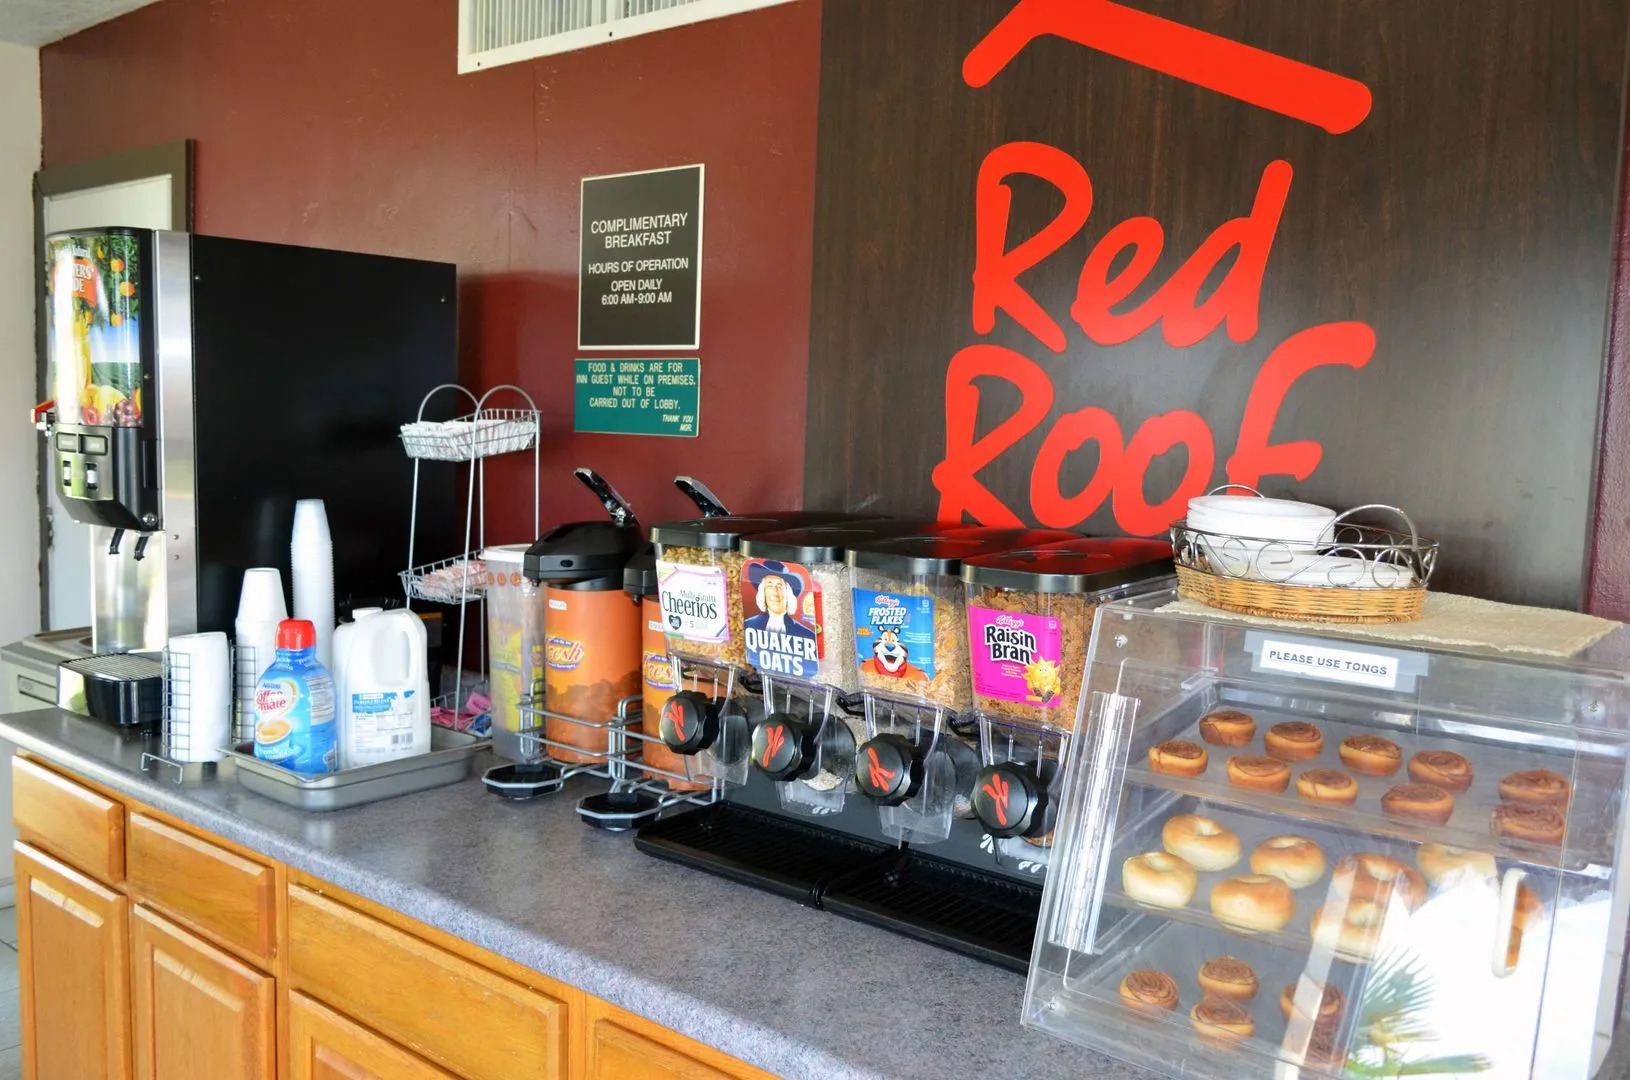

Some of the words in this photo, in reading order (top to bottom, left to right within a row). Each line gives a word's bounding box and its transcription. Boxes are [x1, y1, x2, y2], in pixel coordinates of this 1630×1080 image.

[590, 212, 688, 234] COMPLIMENTARY
[604, 231, 672, 249] BREAKFAST
[972, 141, 1293, 353] Red
[588, 262, 620, 275] HOURS
[621, 261, 634, 273] OF
[635, 257, 689, 272] OPERATION
[611, 280, 636, 292] OPEN
[637, 278, 663, 290] DAILY
[601, 294, 619, 306] 6:00
[657, 291, 673, 303] AM
[588, 362, 607, 373] FOOD
[610, 363, 616, 373] &
[620, 363, 645, 373] DRINKS
[649, 362, 664, 373] ARE
[667, 362, 684, 373] FOR
[576, 374, 588, 384] INN
[591, 374, 614, 385] GUEST
[617, 374, 640, 385] WHILE
[643, 374, 654, 385] ON
[657, 374, 696, 386] PREMISES.
[612, 386, 627, 397] NOT
[632, 386, 642, 397] TO
[645, 386, 656, 397] BE
[589, 397, 618, 408] CARRIED
[621, 398, 636, 408] OUT
[640, 398, 650, 409] OF
[654, 399, 681, 410] LOBBY.
[662, 414, 680, 423] THANK
[682, 415, 694, 423] YOU
[661, 590, 718, 620] Cheerios
[868, 607, 907, 617] FROSTED
[870, 615, 904, 625] FLAKES
[745, 628, 818, 662] QUAKER
[985, 625, 1036, 651] Raisin
[992, 643, 1031, 665] Bran
[1269, 650, 1314, 664] PLEASE
[1317, 657, 1341, 669] USE
[1345, 661, 1387, 675] TONGS
[759, 651, 804, 677] OATS
